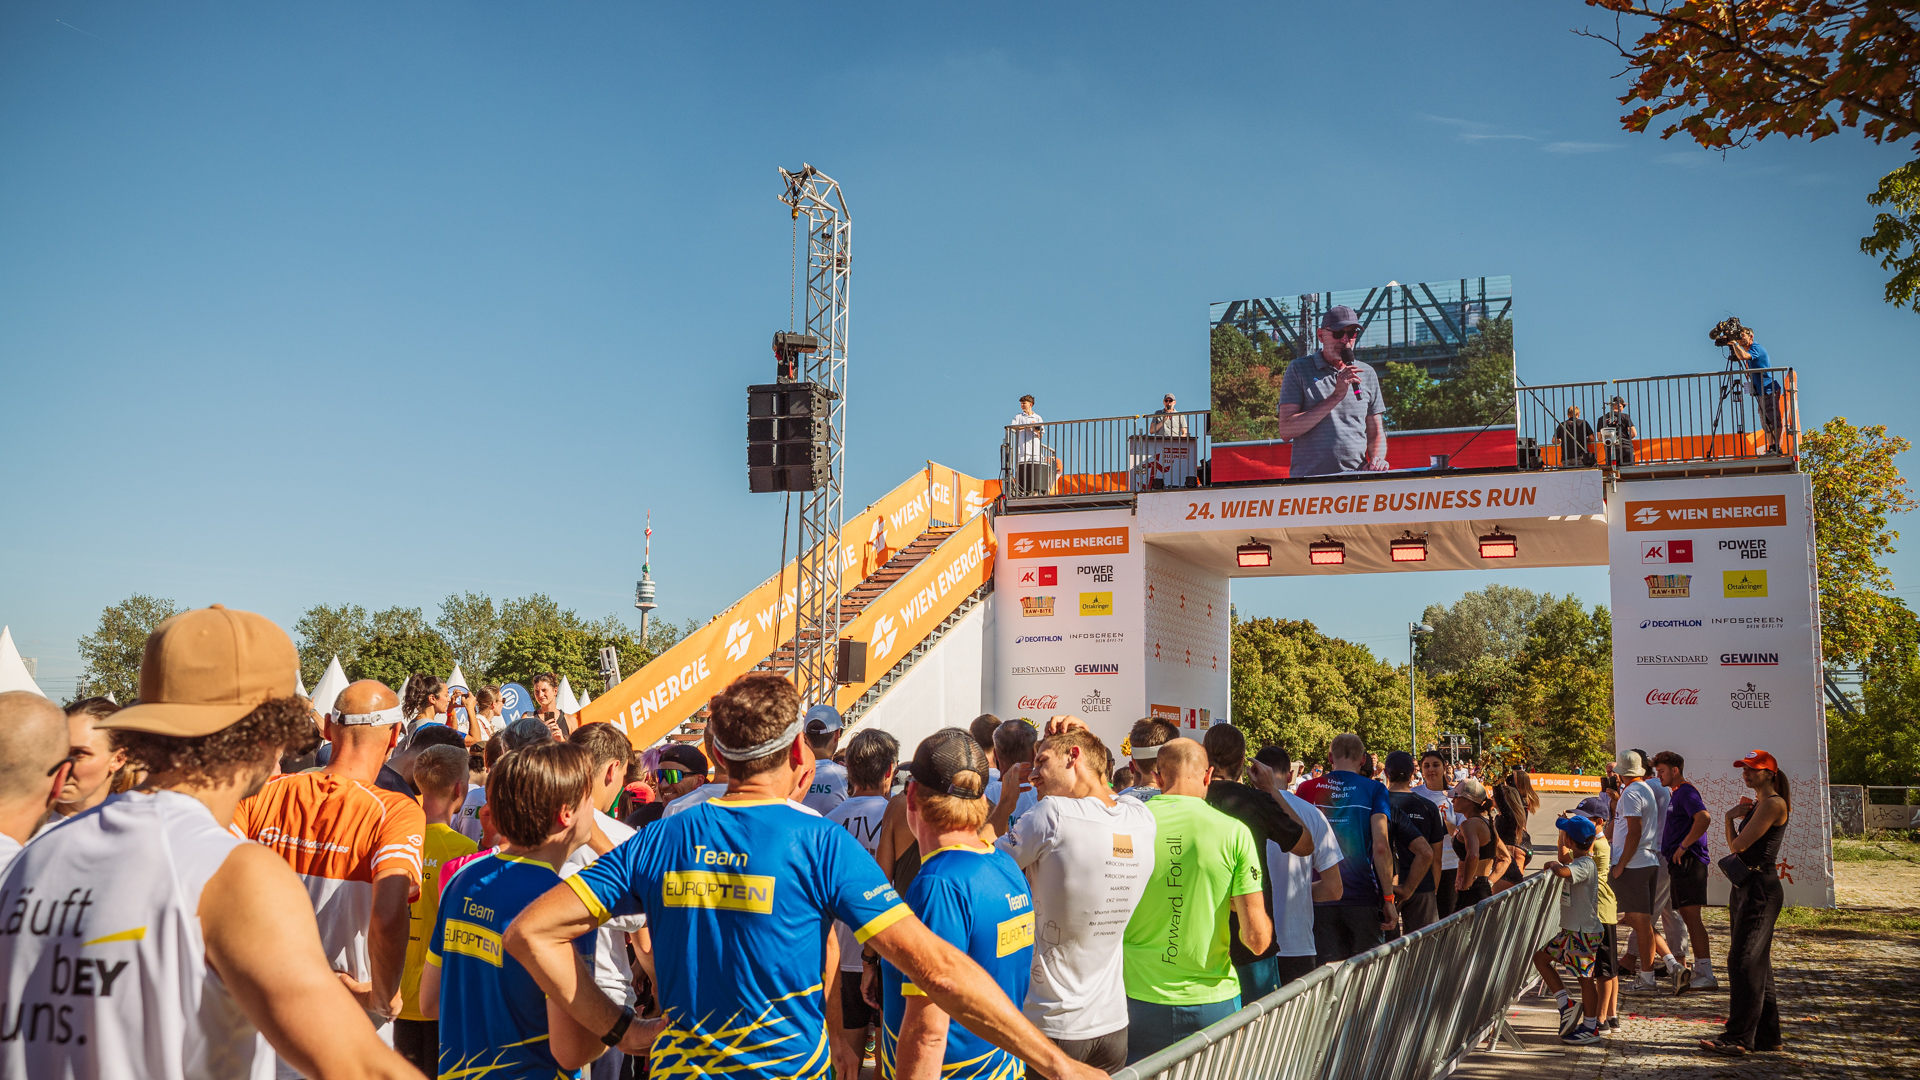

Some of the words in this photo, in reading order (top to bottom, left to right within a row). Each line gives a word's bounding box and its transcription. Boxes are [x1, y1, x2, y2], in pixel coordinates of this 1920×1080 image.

[1185, 502, 1215, 520] 24.
[1221, 499, 1274, 519] WIEN
[1278, 494, 1370, 517] ENERGIE
[1373, 489, 1482, 512] BUSINESS
[1486, 486, 1537, 507] RUN
[890, 495, 925, 532] WIEN
[1667, 508, 1708, 520] WIEN
[1712, 505, 1779, 519] ENERGIE
[1039, 538, 1070, 549] WIEN
[1073, 535, 1124, 548] ENERGIE
[1718, 539, 1766, 550] POWER
[1645, 546, 1663, 558] AK
[1741, 549, 1767, 559] ADE
[1021, 572, 1035, 582] AK
[1077, 565, 1113, 575] POWER
[1093, 574, 1113, 582] ADE
[900, 580, 938, 629] WIEN
[937, 537, 991, 597] ENERGIE
[756, 586, 798, 633] WIEN
[1652, 619, 1702, 628] DECATHLON
[1025, 635, 1063, 643] DECATHLON
[1720, 653, 1779, 663] GEWINN
[1075, 663, 1118, 673] GEWINN
[630, 653, 711, 729] ENERGIE
[1081, 705, 1111, 713] QUELLE
[1731, 701, 1770, 710] QUELLE
[1166, 835, 1182, 855] all.
[694, 845, 749, 867] Team
[1167, 859, 1182, 888] For
[666, 881, 767, 902] EUROPTEN
[463, 896, 495, 922] Team
[1005, 893, 1029, 911] Team
[1161, 893, 1184, 966] Forward.
[52, 943, 130, 997] bEY
[0, 1001, 88, 1047] uns.
